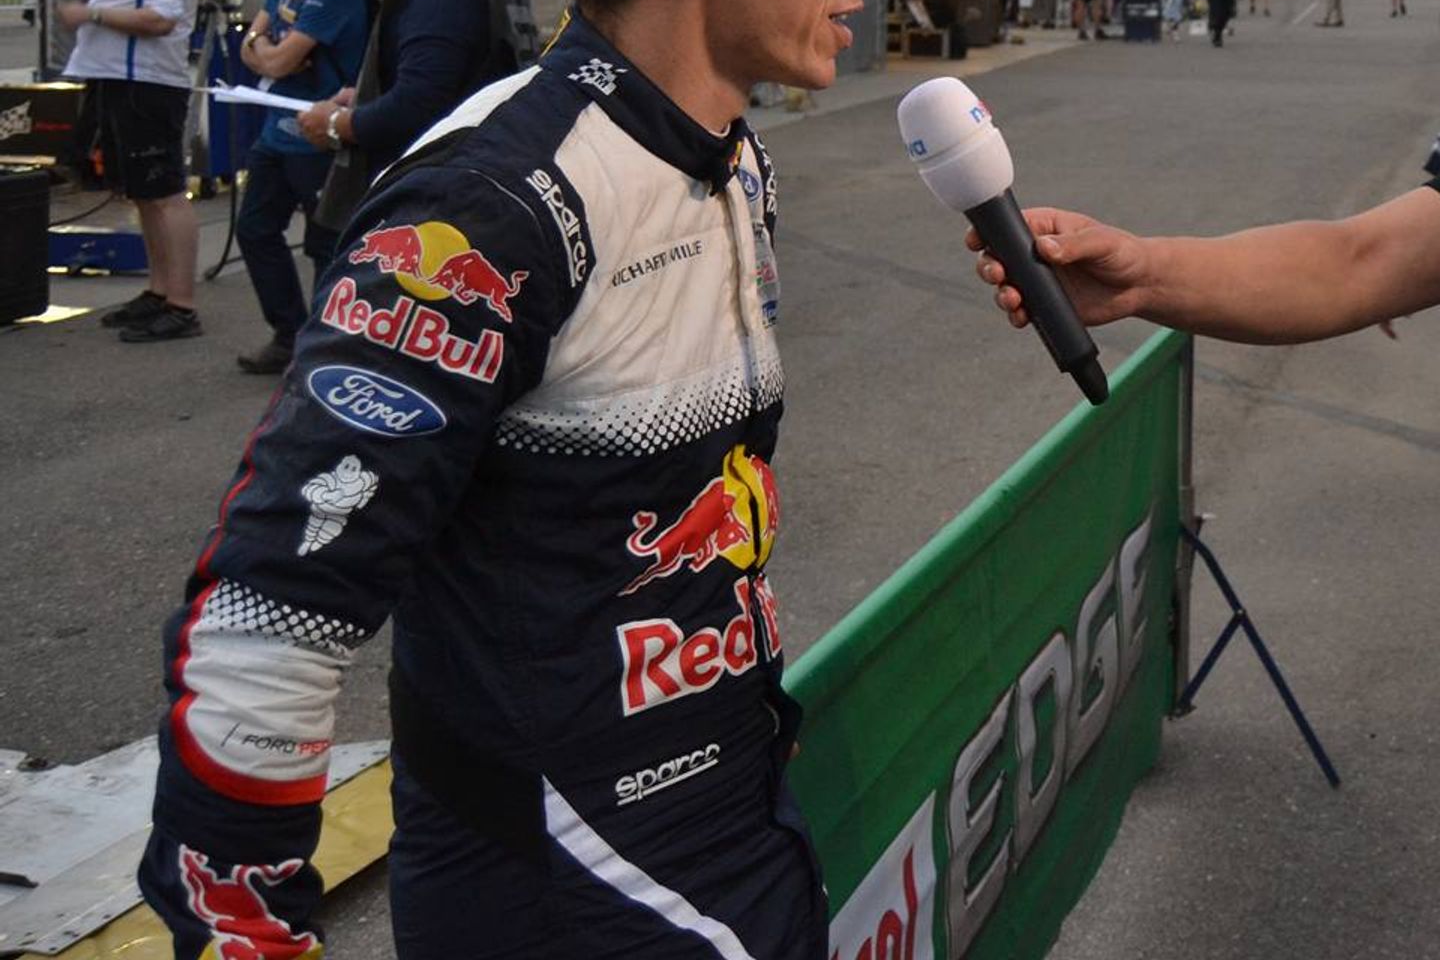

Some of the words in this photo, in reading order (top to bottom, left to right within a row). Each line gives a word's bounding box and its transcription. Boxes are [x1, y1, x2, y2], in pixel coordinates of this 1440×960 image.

[321, 277, 415, 349] Red
[400, 305, 504, 384] Bull
[327, 374, 423, 431] Ford
[617, 576, 758, 717] Red
[242, 734, 297, 754] FORD
[615, 744, 721, 806] sparco
[948, 508, 1152, 960] EDGE
